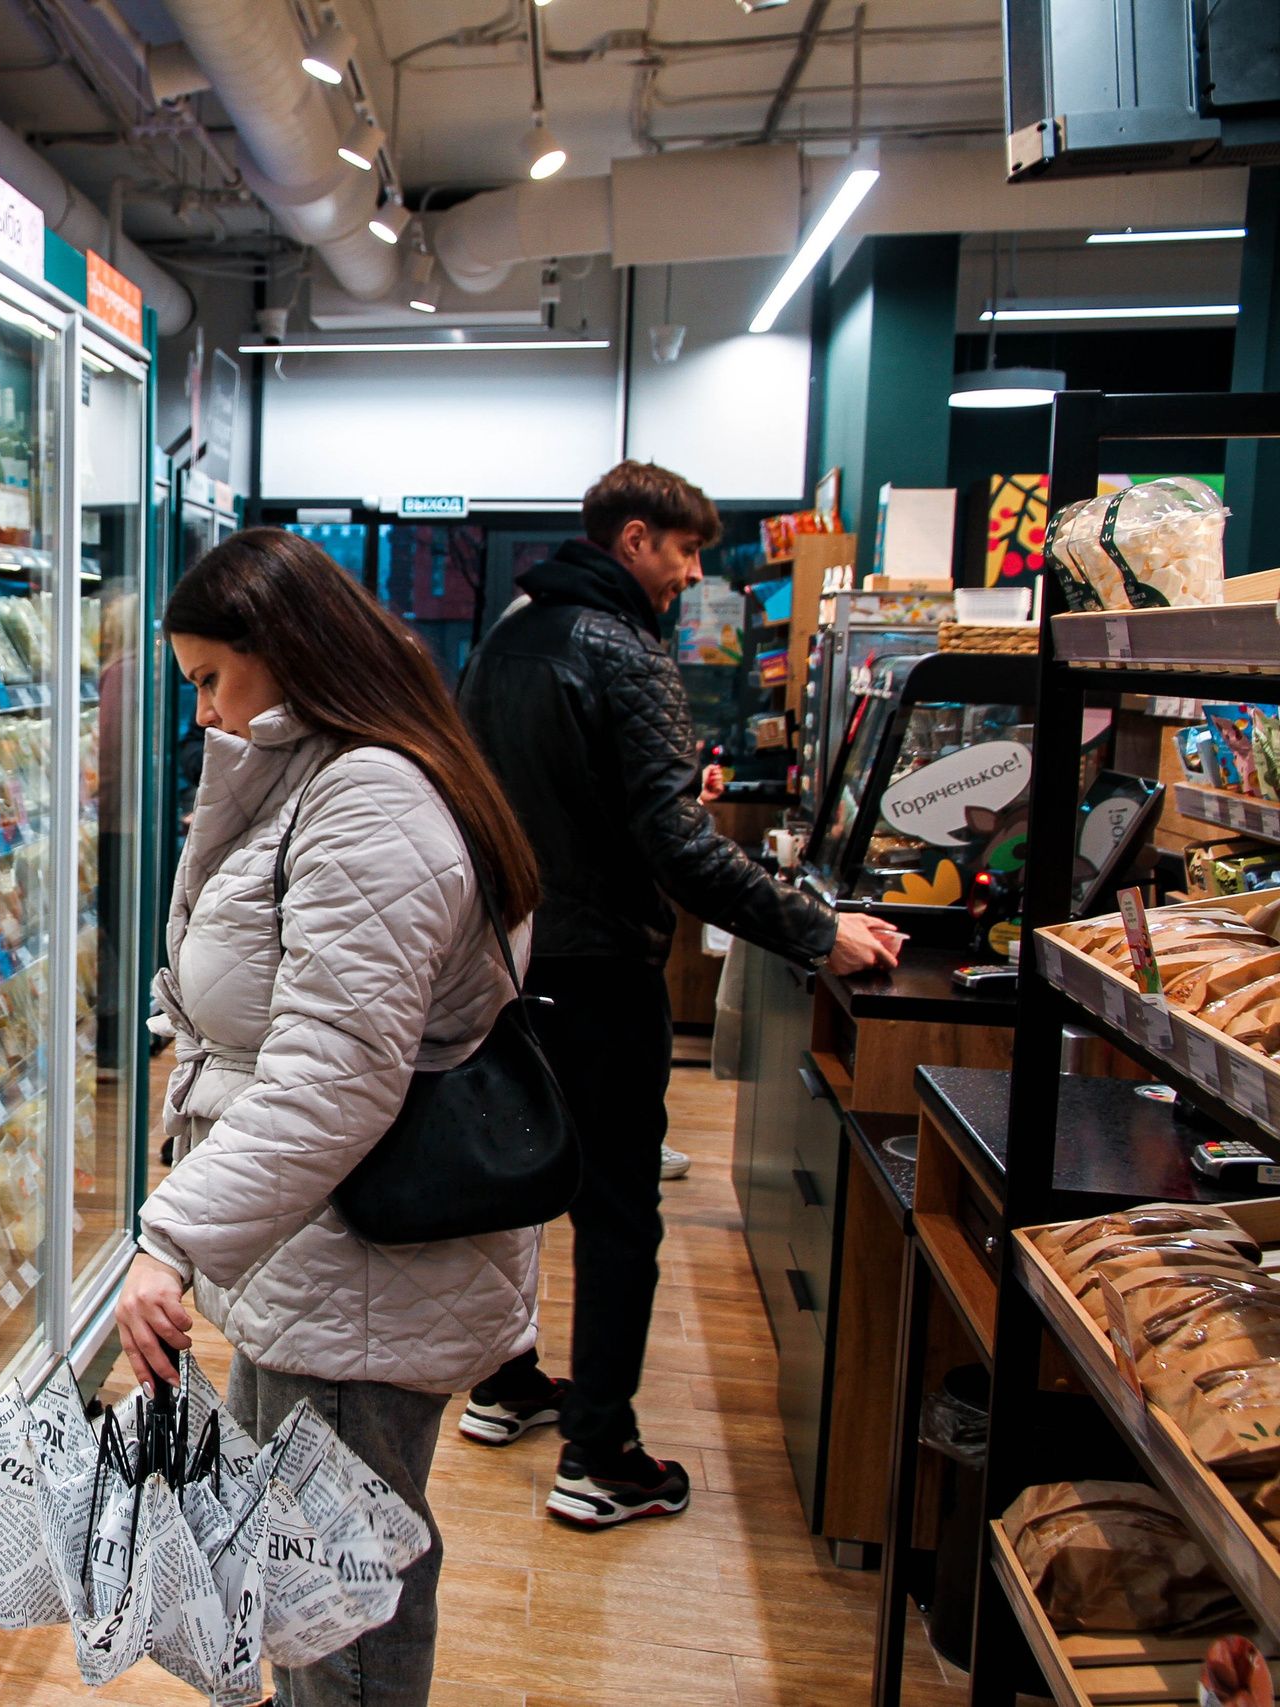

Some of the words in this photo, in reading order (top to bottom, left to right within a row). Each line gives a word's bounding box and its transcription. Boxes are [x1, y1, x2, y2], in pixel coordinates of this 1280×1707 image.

[404, 497, 461, 511] ВЫХОД
[890, 751, 1023, 818] Горяченькое!
[5, 1485, 32, 1500] Published
[139, 1559, 148, 1586] The
[92, 1585, 133, 1653] Soir
